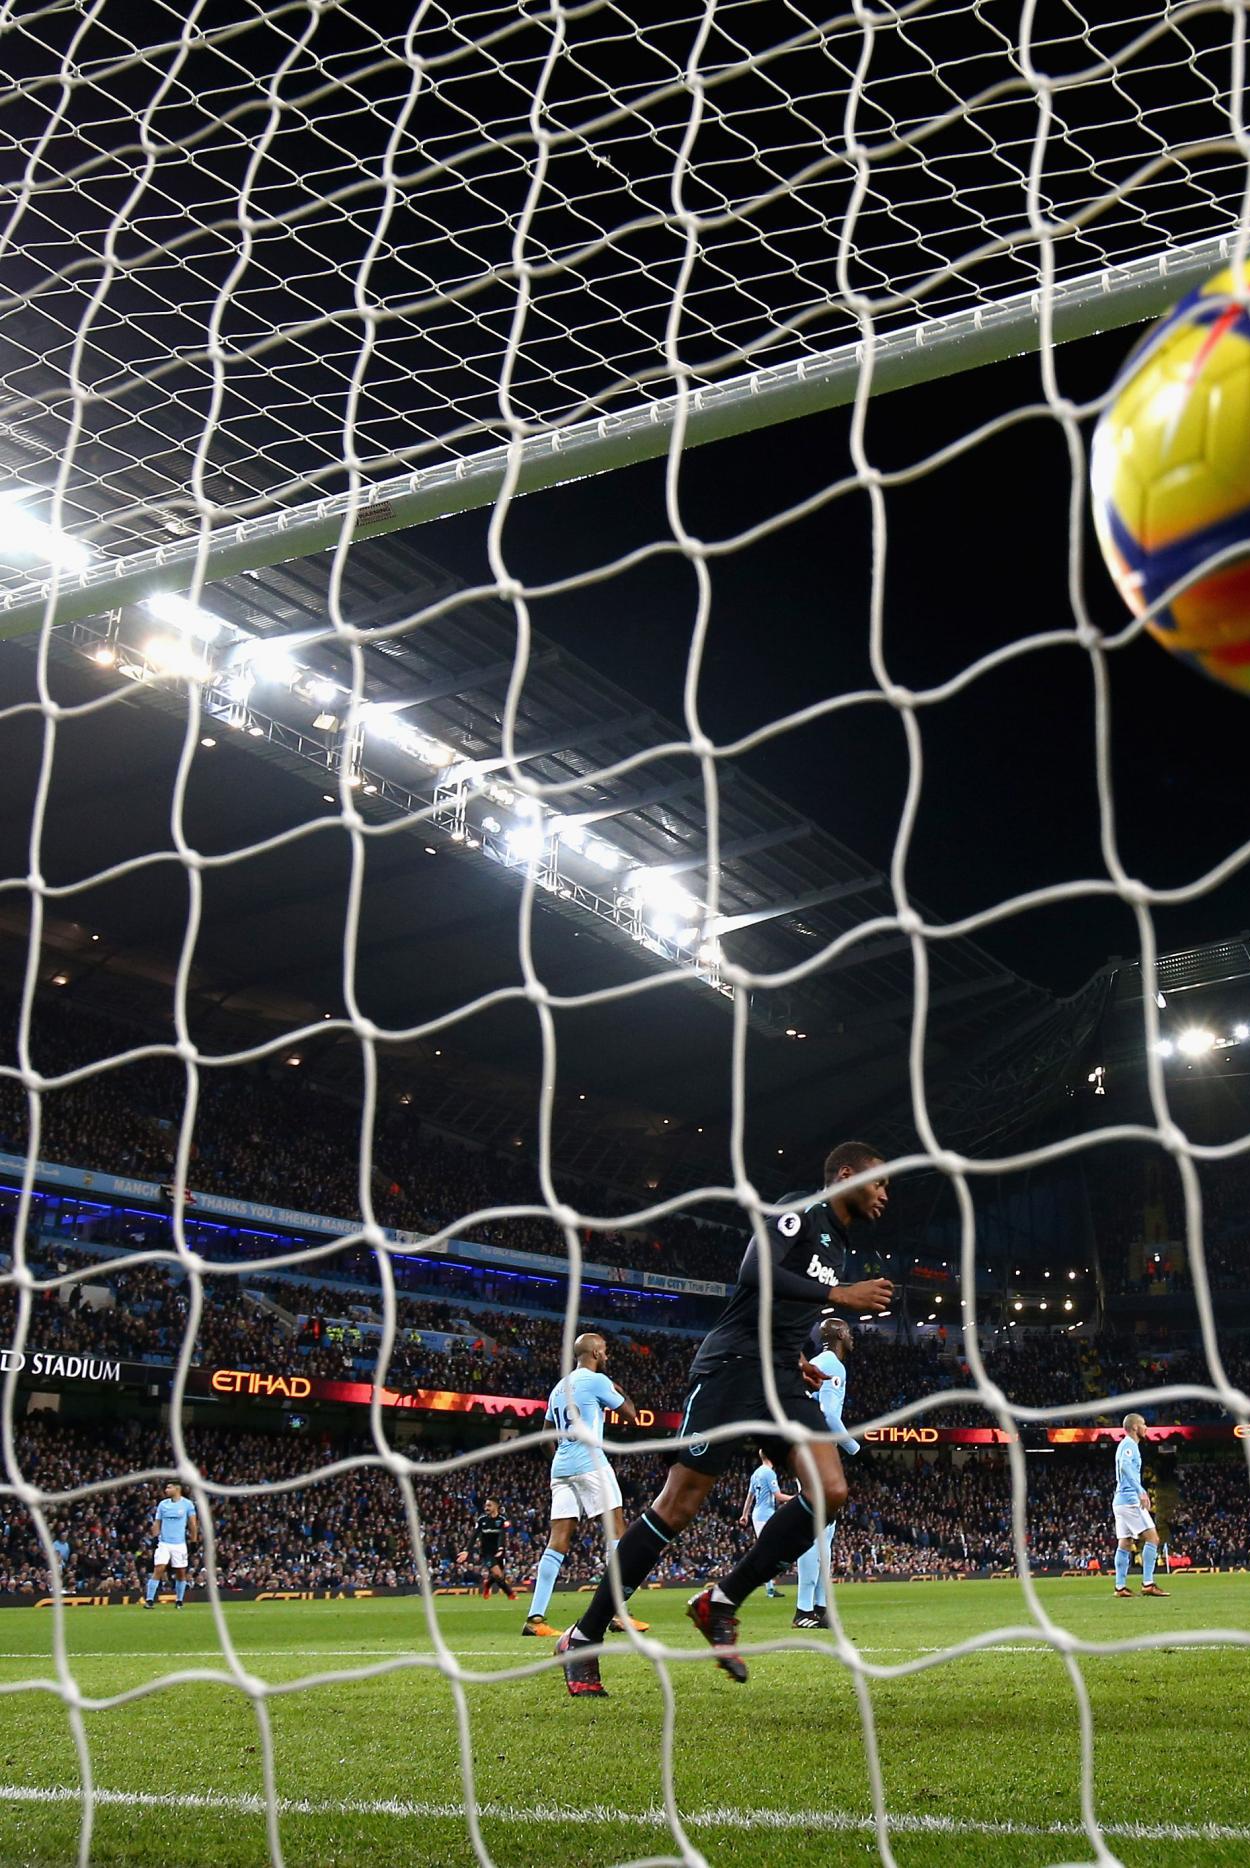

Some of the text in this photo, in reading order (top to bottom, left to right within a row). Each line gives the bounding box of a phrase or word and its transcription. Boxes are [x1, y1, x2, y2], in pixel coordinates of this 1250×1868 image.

[113, 1179, 160, 1198] MANCH
[200, 1195, 247, 1214] THANKS
[278, 1210, 320, 1228] SHEIKH
[321, 1219, 366, 1234] MANSOU
[31, 1352, 121, 1382] STADIUM
[211, 1369, 312, 1398] ETIHAD
[863, 1427, 939, 1443] ETIHAD
